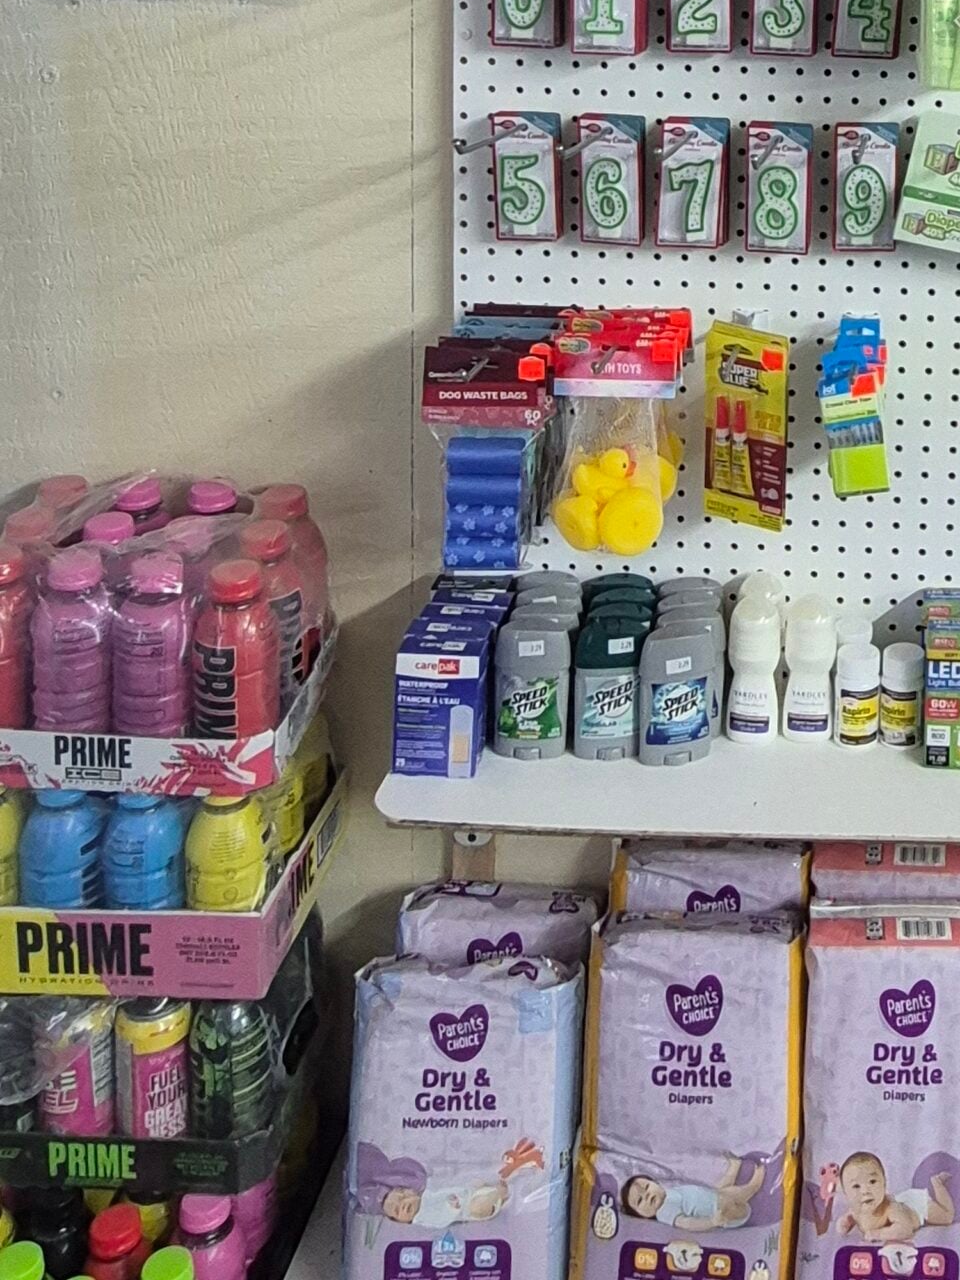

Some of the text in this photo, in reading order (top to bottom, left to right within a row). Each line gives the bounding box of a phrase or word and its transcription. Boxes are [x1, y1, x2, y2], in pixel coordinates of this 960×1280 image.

[500, 154, 545, 225] 5
[584, 157, 627, 229] 6
[669, 159, 714, 232] 7
[842, 164, 887, 237] 9
[753, 165, 799, 239] 8
[616, 363, 642, 375] TOYS
[439, 391, 528, 400] DOG WASTE BAGS
[524, 409, 541, 420] 60
[398, 680, 449, 689] WATERPROOF
[511, 685, 548, 705] SPEED
[593, 681, 633, 705] SPEED
[927, 679, 946, 688] Light
[515, 697, 548, 716] STICK
[599, 693, 633, 717] STICK
[662, 687, 698, 711] SPEED
[667, 697, 699, 721] STICK
[842, 706, 871, 715] Aspirin
[54, 735, 132, 769] PRIME
[16, 921, 154, 976] PRIME
[672, 988, 719, 1012] Parent's
[886, 990, 932, 1015] Parent's
[682, 1007, 716, 1025] CHOICE
[895, 1010, 930, 1027] CHOICE
[437, 1016, 484, 1040] Parent's
[447, 1033, 480, 1052] CHOICE
[659, 1040, 727, 1067] Dry &
[873, 1043, 938, 1067] Dry &
[151, 1065, 182, 1091] FUEL
[422, 1069, 491, 1093] Dry &
[651, 1066, 733, 1089] Gentle
[866, 1065, 943, 1087] Gentle
[147, 1084, 186, 1111] YOUR
[414, 1090, 497, 1113] Gentle
[668, 1092, 714, 1106] Diapers
[882, 1090, 926, 1103] Diapers
[402, 1116, 508, 1131] Newborn Diapers
[48, 1141, 138, 1180] PRIME
[402, 1252, 420, 1264] 0%
[637, 1253, 656, 1265] 0%
[852, 1258, 870, 1270] 0%
